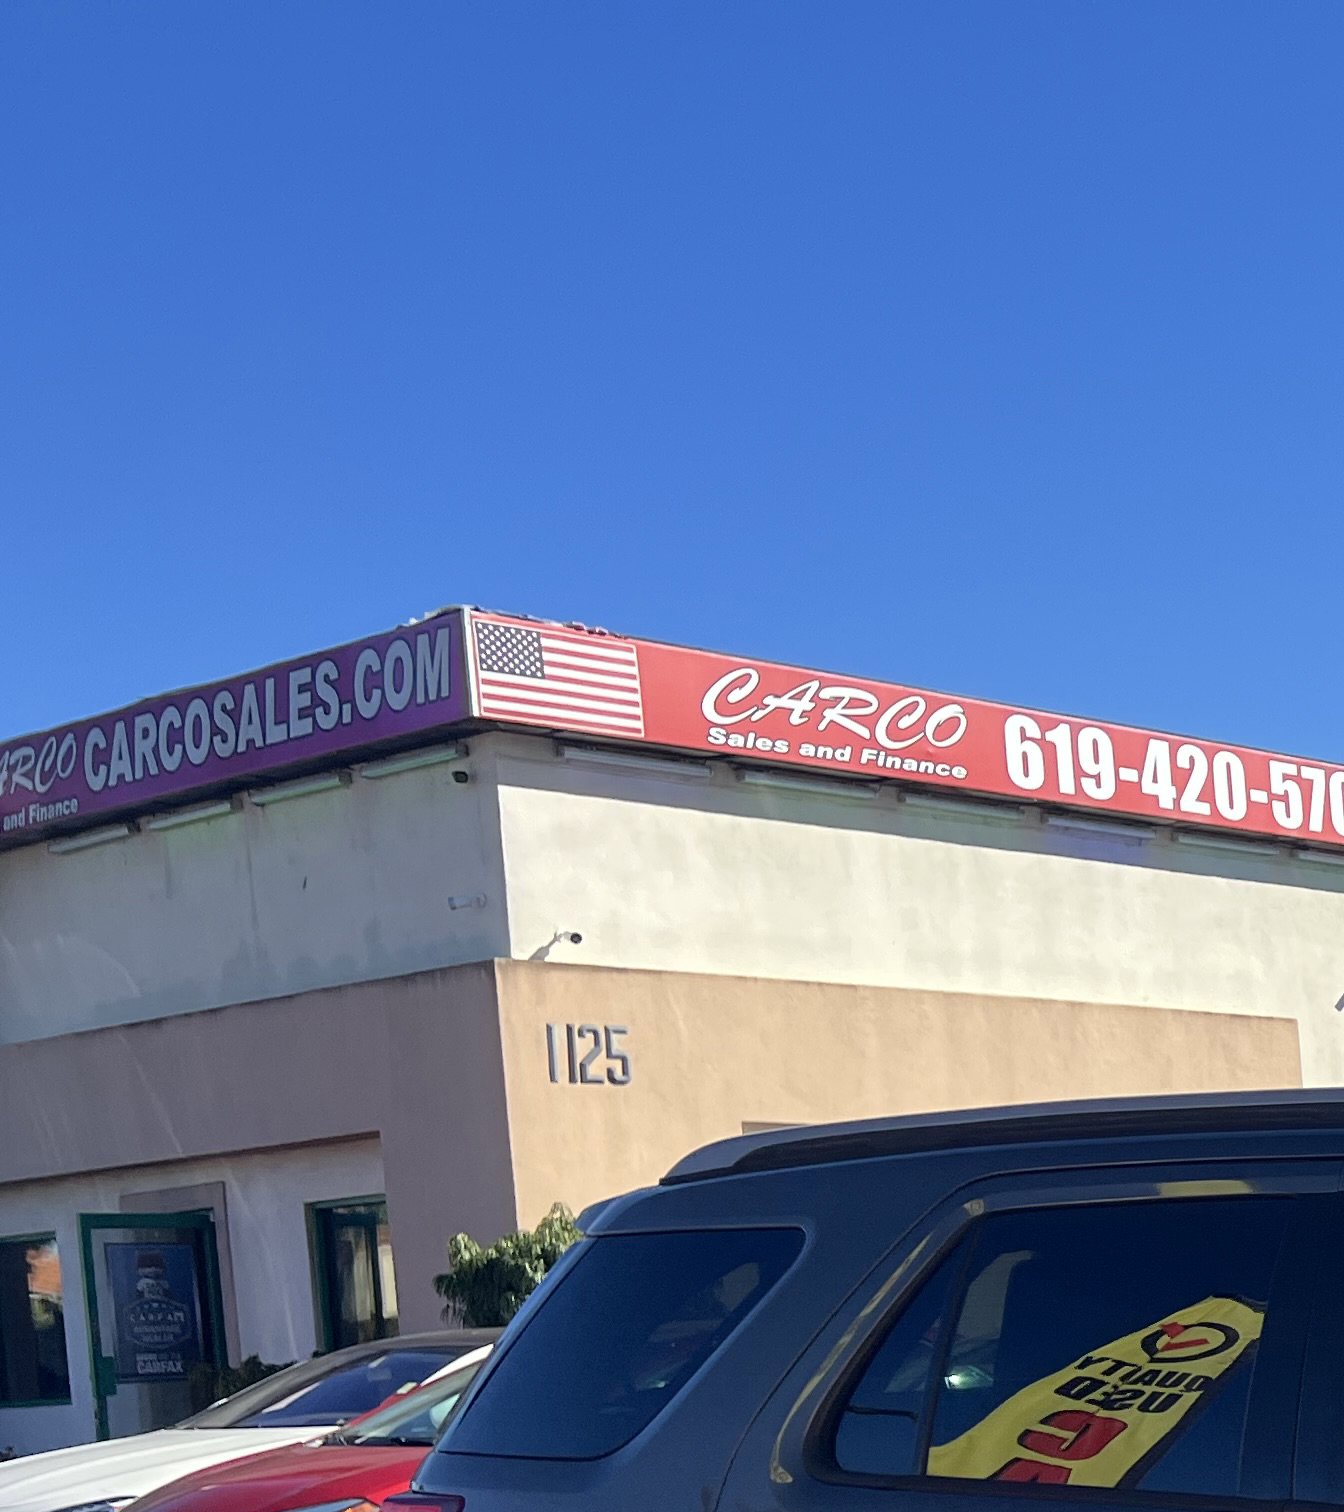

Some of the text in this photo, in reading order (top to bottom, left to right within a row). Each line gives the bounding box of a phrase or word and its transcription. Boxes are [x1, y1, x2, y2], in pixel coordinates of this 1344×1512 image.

[83, 627, 451, 792] CARCOSALES.COM
[701, 667, 968, 750] CARCO
[707, 726, 968, 779] Sales and Finance
[4, 798, 79, 831] and Finance
[545, 1022, 633, 1085] 1125
